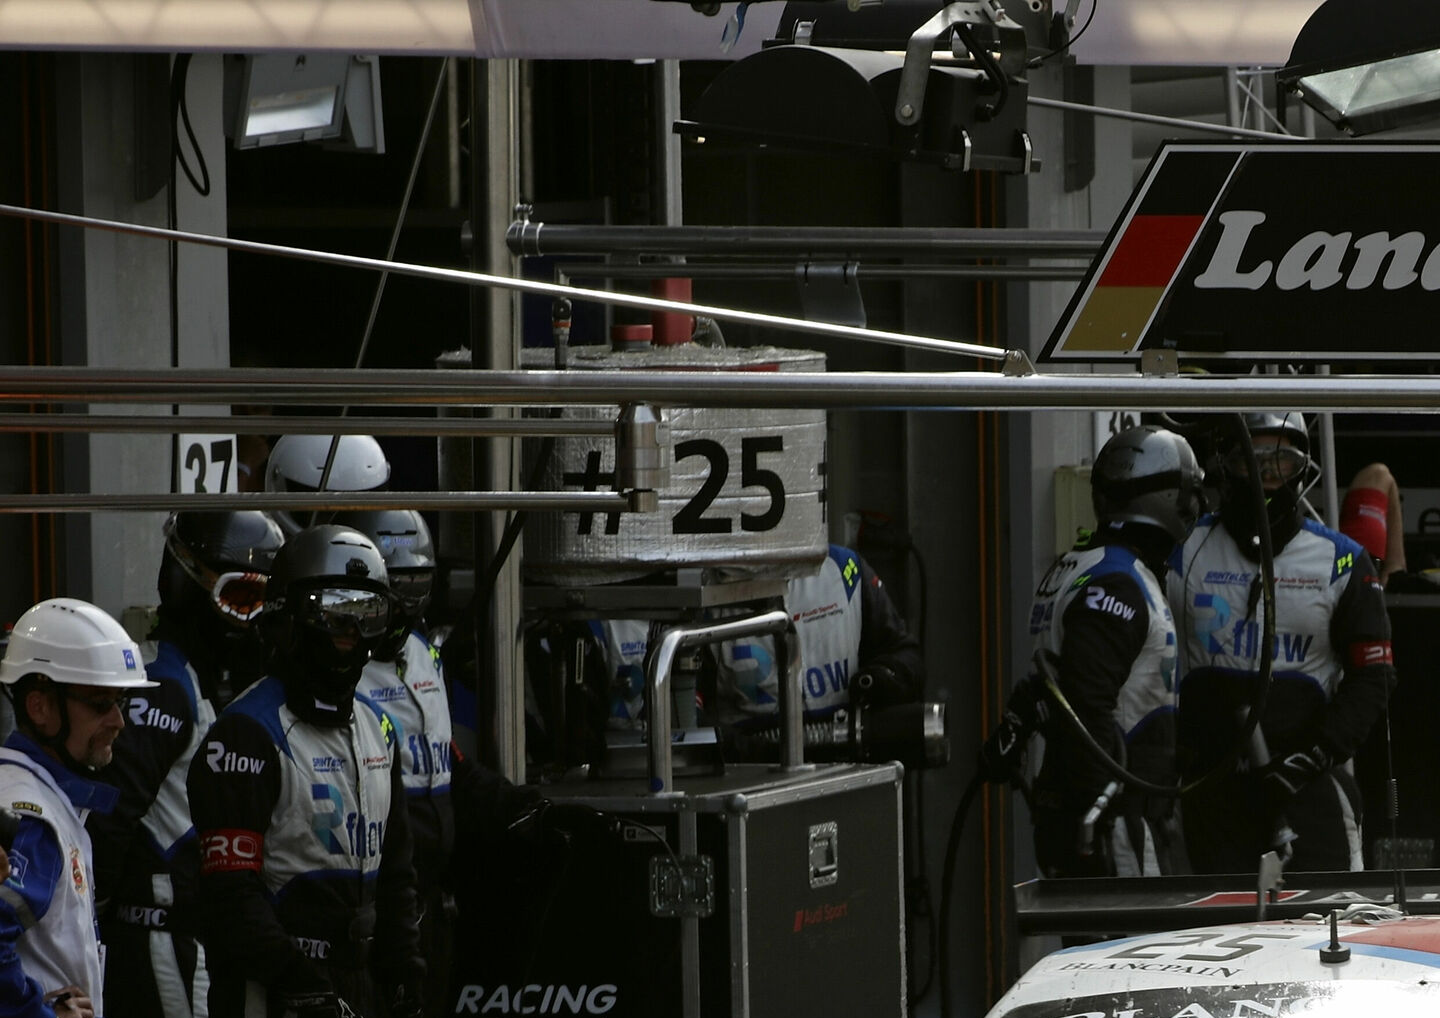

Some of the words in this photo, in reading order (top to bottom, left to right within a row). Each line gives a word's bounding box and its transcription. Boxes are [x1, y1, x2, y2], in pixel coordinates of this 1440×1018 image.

[186, 440, 233, 493] 37
[672, 435, 786, 535] 25
[128, 696, 184, 734] Rflow
[206, 741, 267, 775] Rflow
[201, 835, 258, 860] RO
[1104, 933, 1300, 961] 25
[1059, 962, 1242, 978] BLANCPAIN
[455, 984, 618, 1015] RACING
